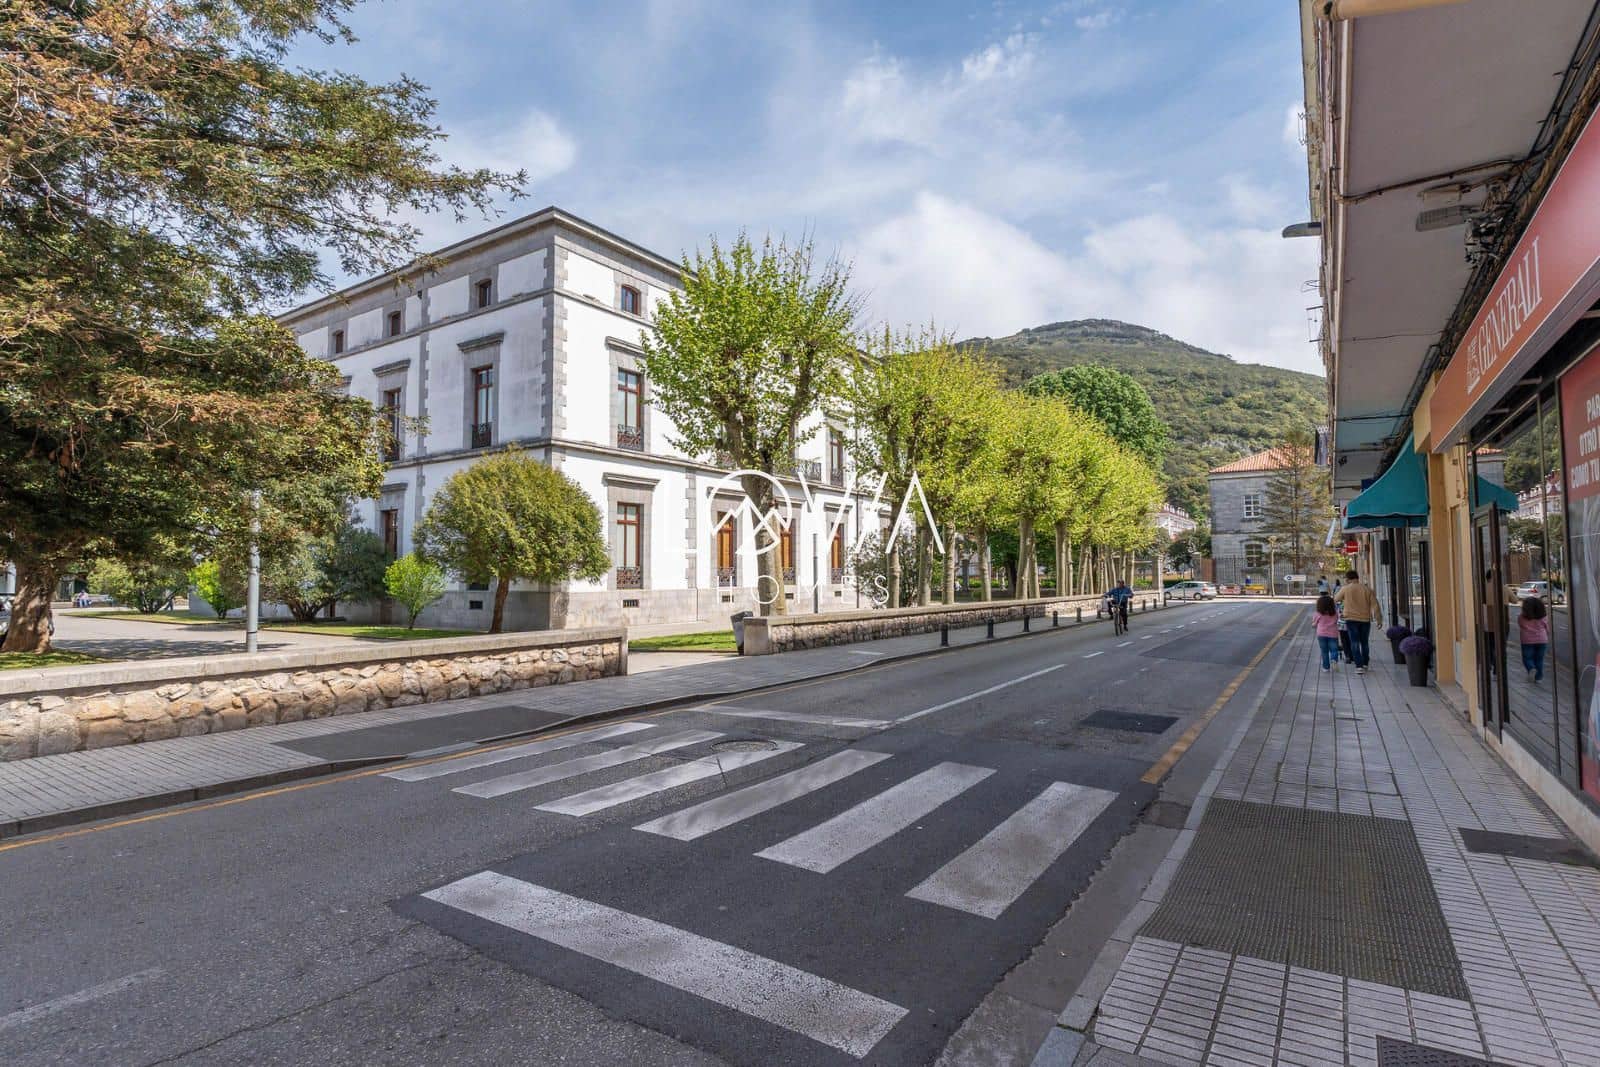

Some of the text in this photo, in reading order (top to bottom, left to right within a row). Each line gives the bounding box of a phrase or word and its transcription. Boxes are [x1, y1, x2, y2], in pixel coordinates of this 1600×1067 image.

[1478, 236, 1543, 376] GENERALI
[1578, 427, 1597, 457] OTRO
[1570, 461, 1589, 489] COMO
